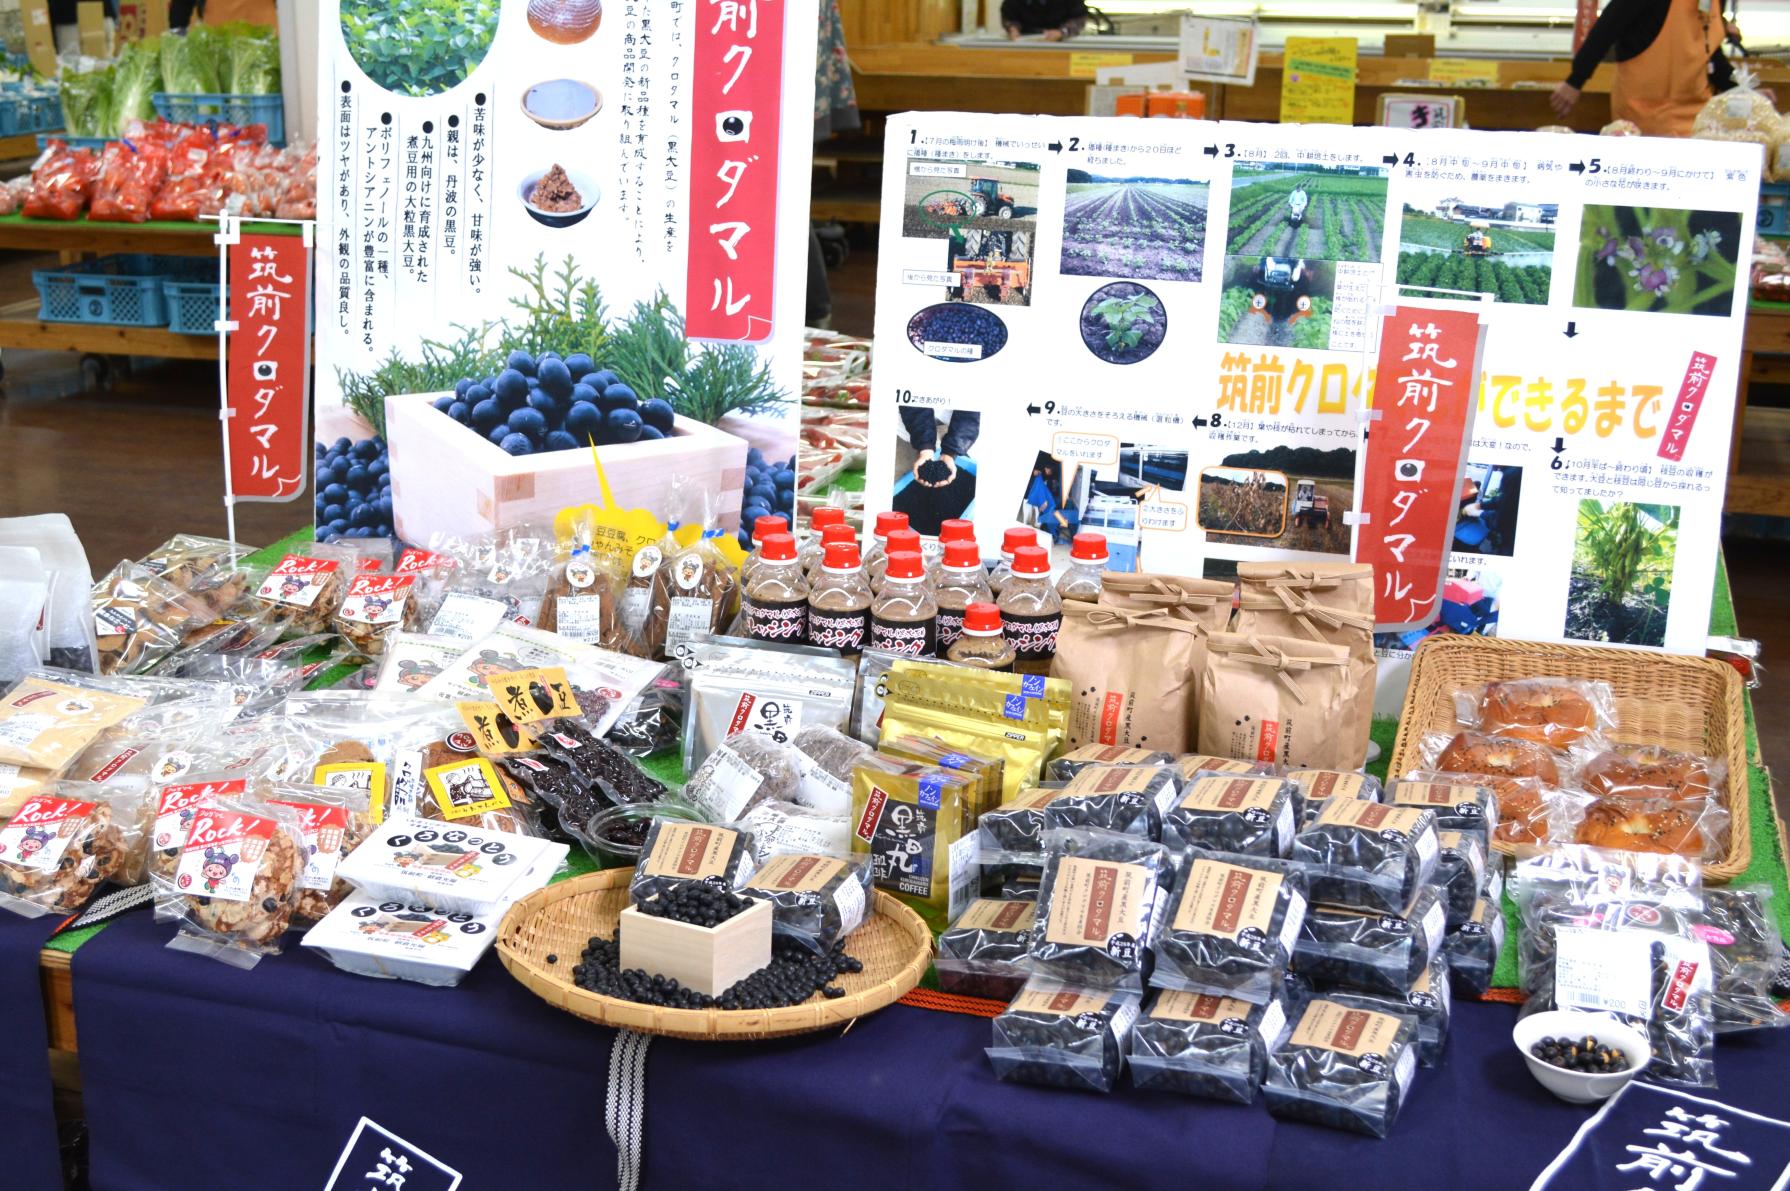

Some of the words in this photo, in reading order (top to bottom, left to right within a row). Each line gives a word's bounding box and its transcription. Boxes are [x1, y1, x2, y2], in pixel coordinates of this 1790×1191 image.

[618, 0, 638, 221] 豆の商品開発に取り組んでいます。
[633, 0, 652, 262] た黒大豆の新品種を育成することにより、
[338, 95, 352, 335] 表面はツヤがあり、外観の品質良し。
[362, 127, 377, 352] アントシアニンが豊富に含まれる。
[377, 127, 392, 279] ポリフェノールの一種、
[402, 135, 419, 274] 煮豆用の大粒黒大豆。
[417, 136, 434, 283] 九州向けに育成された
[444, 130, 459, 255] 親は、丹波の黒豆。
[246, 246, 293, 479] 筑前クロダマル
[1665, 356, 1710, 454] 筑前クロダマル
[1383, 323, 1457, 600] 筑前クロダマル
[276, 559, 325, 573] Rock!
[351, 576, 403, 595] Rock!
[13, 802, 82, 823] Rock!
[189, 818, 259, 844] Rock!
[899, 882, 929, 896] COFFEE
[1110, 946, 1132, 958] 新豆
